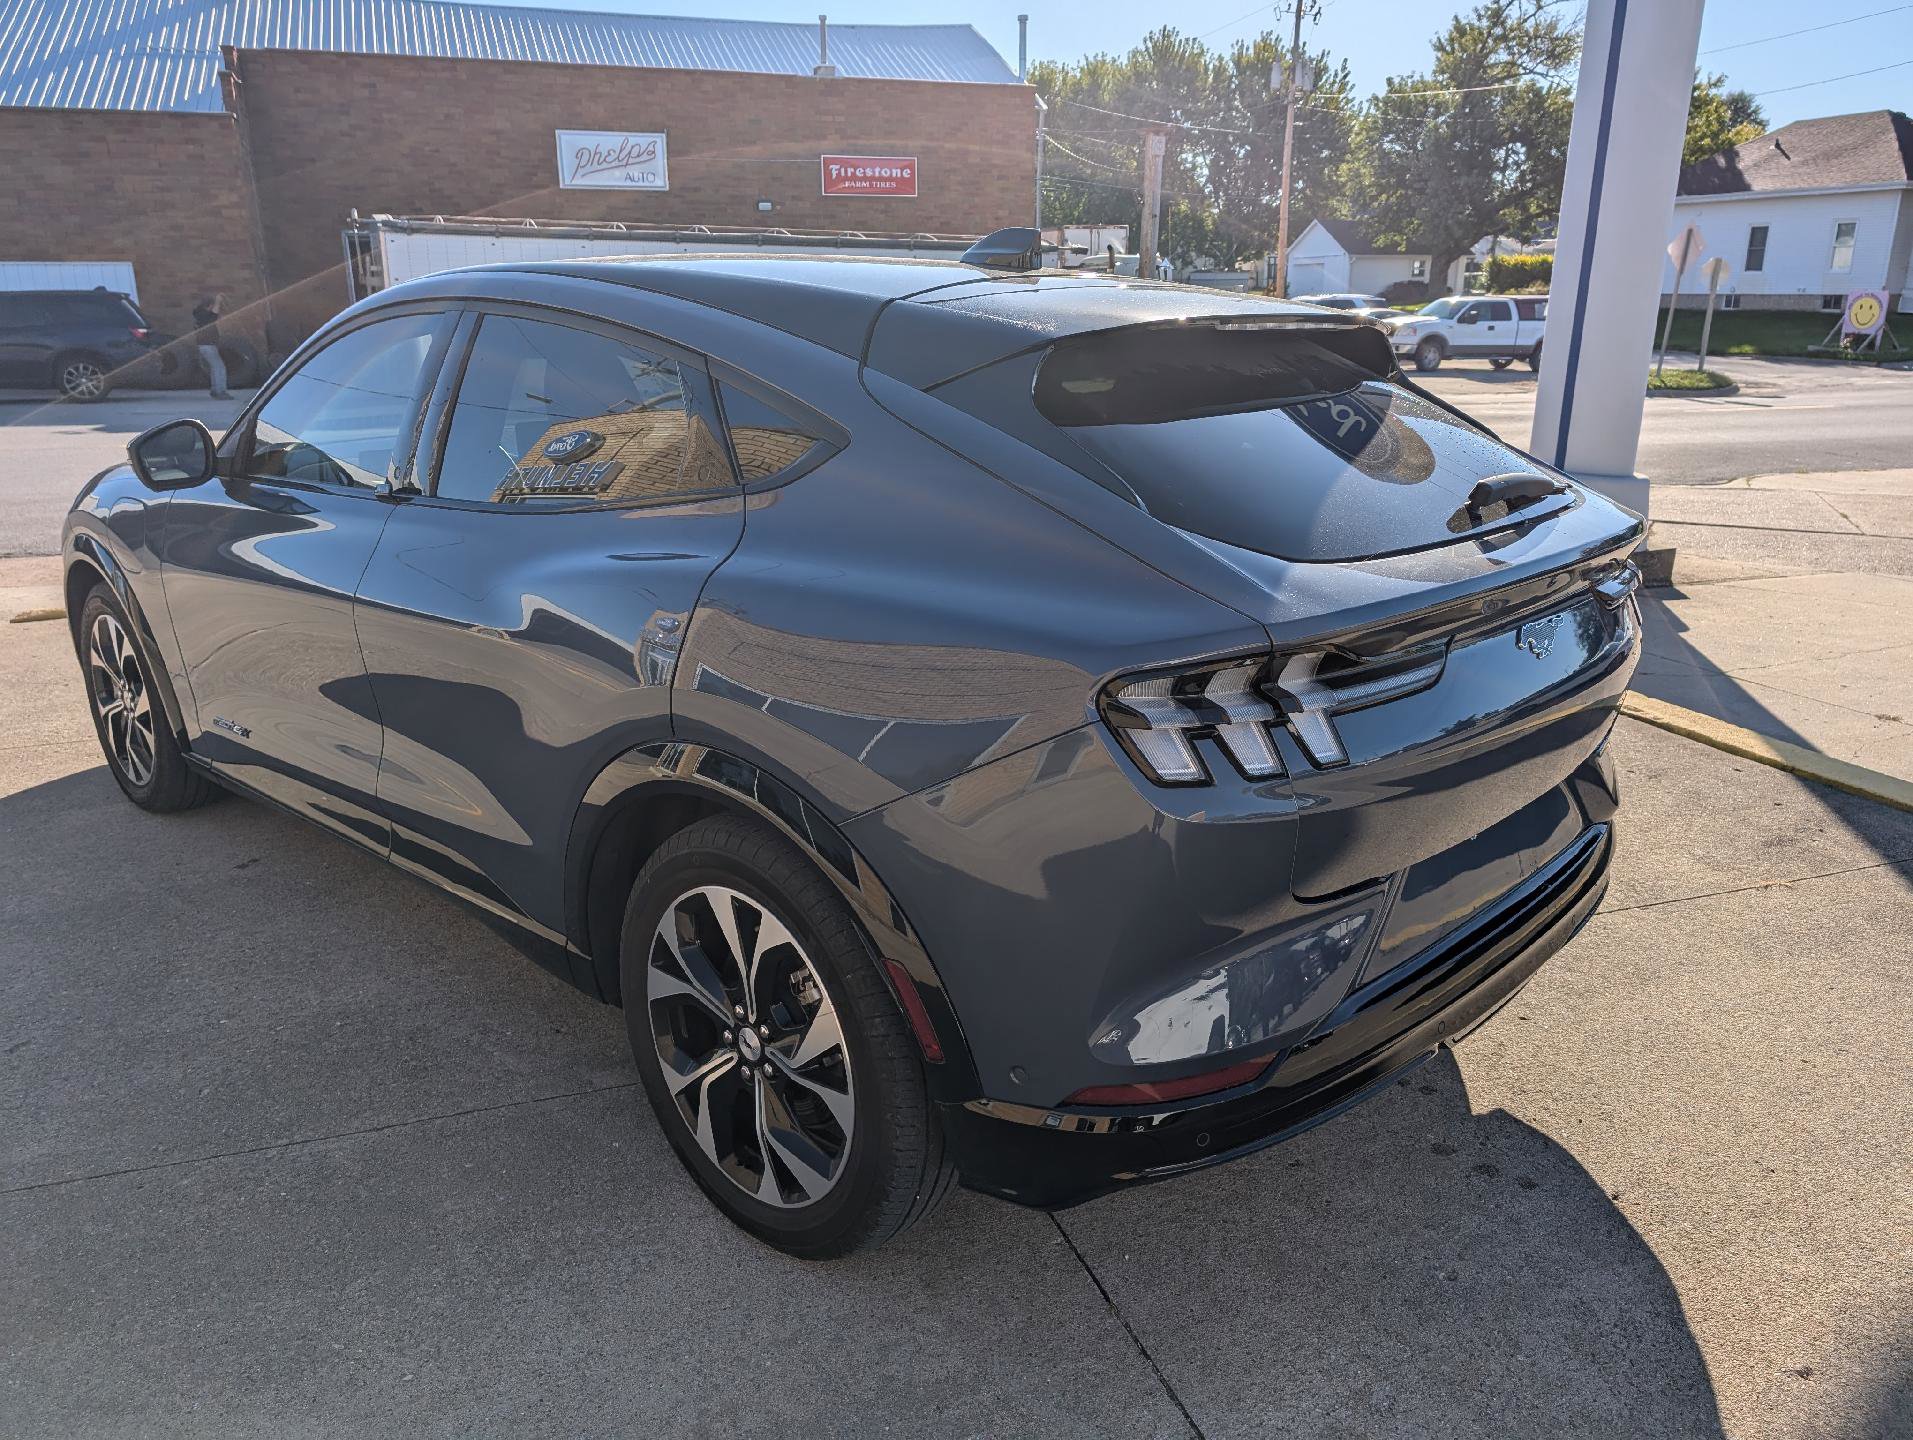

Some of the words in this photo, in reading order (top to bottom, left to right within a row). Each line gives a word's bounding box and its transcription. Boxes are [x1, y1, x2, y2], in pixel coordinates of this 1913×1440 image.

[624, 171, 656, 184] AUTO
[829, 164, 911, 179] Firestone
[844, 180, 870, 188] FARM
[872, 181, 897, 189] TIRES
